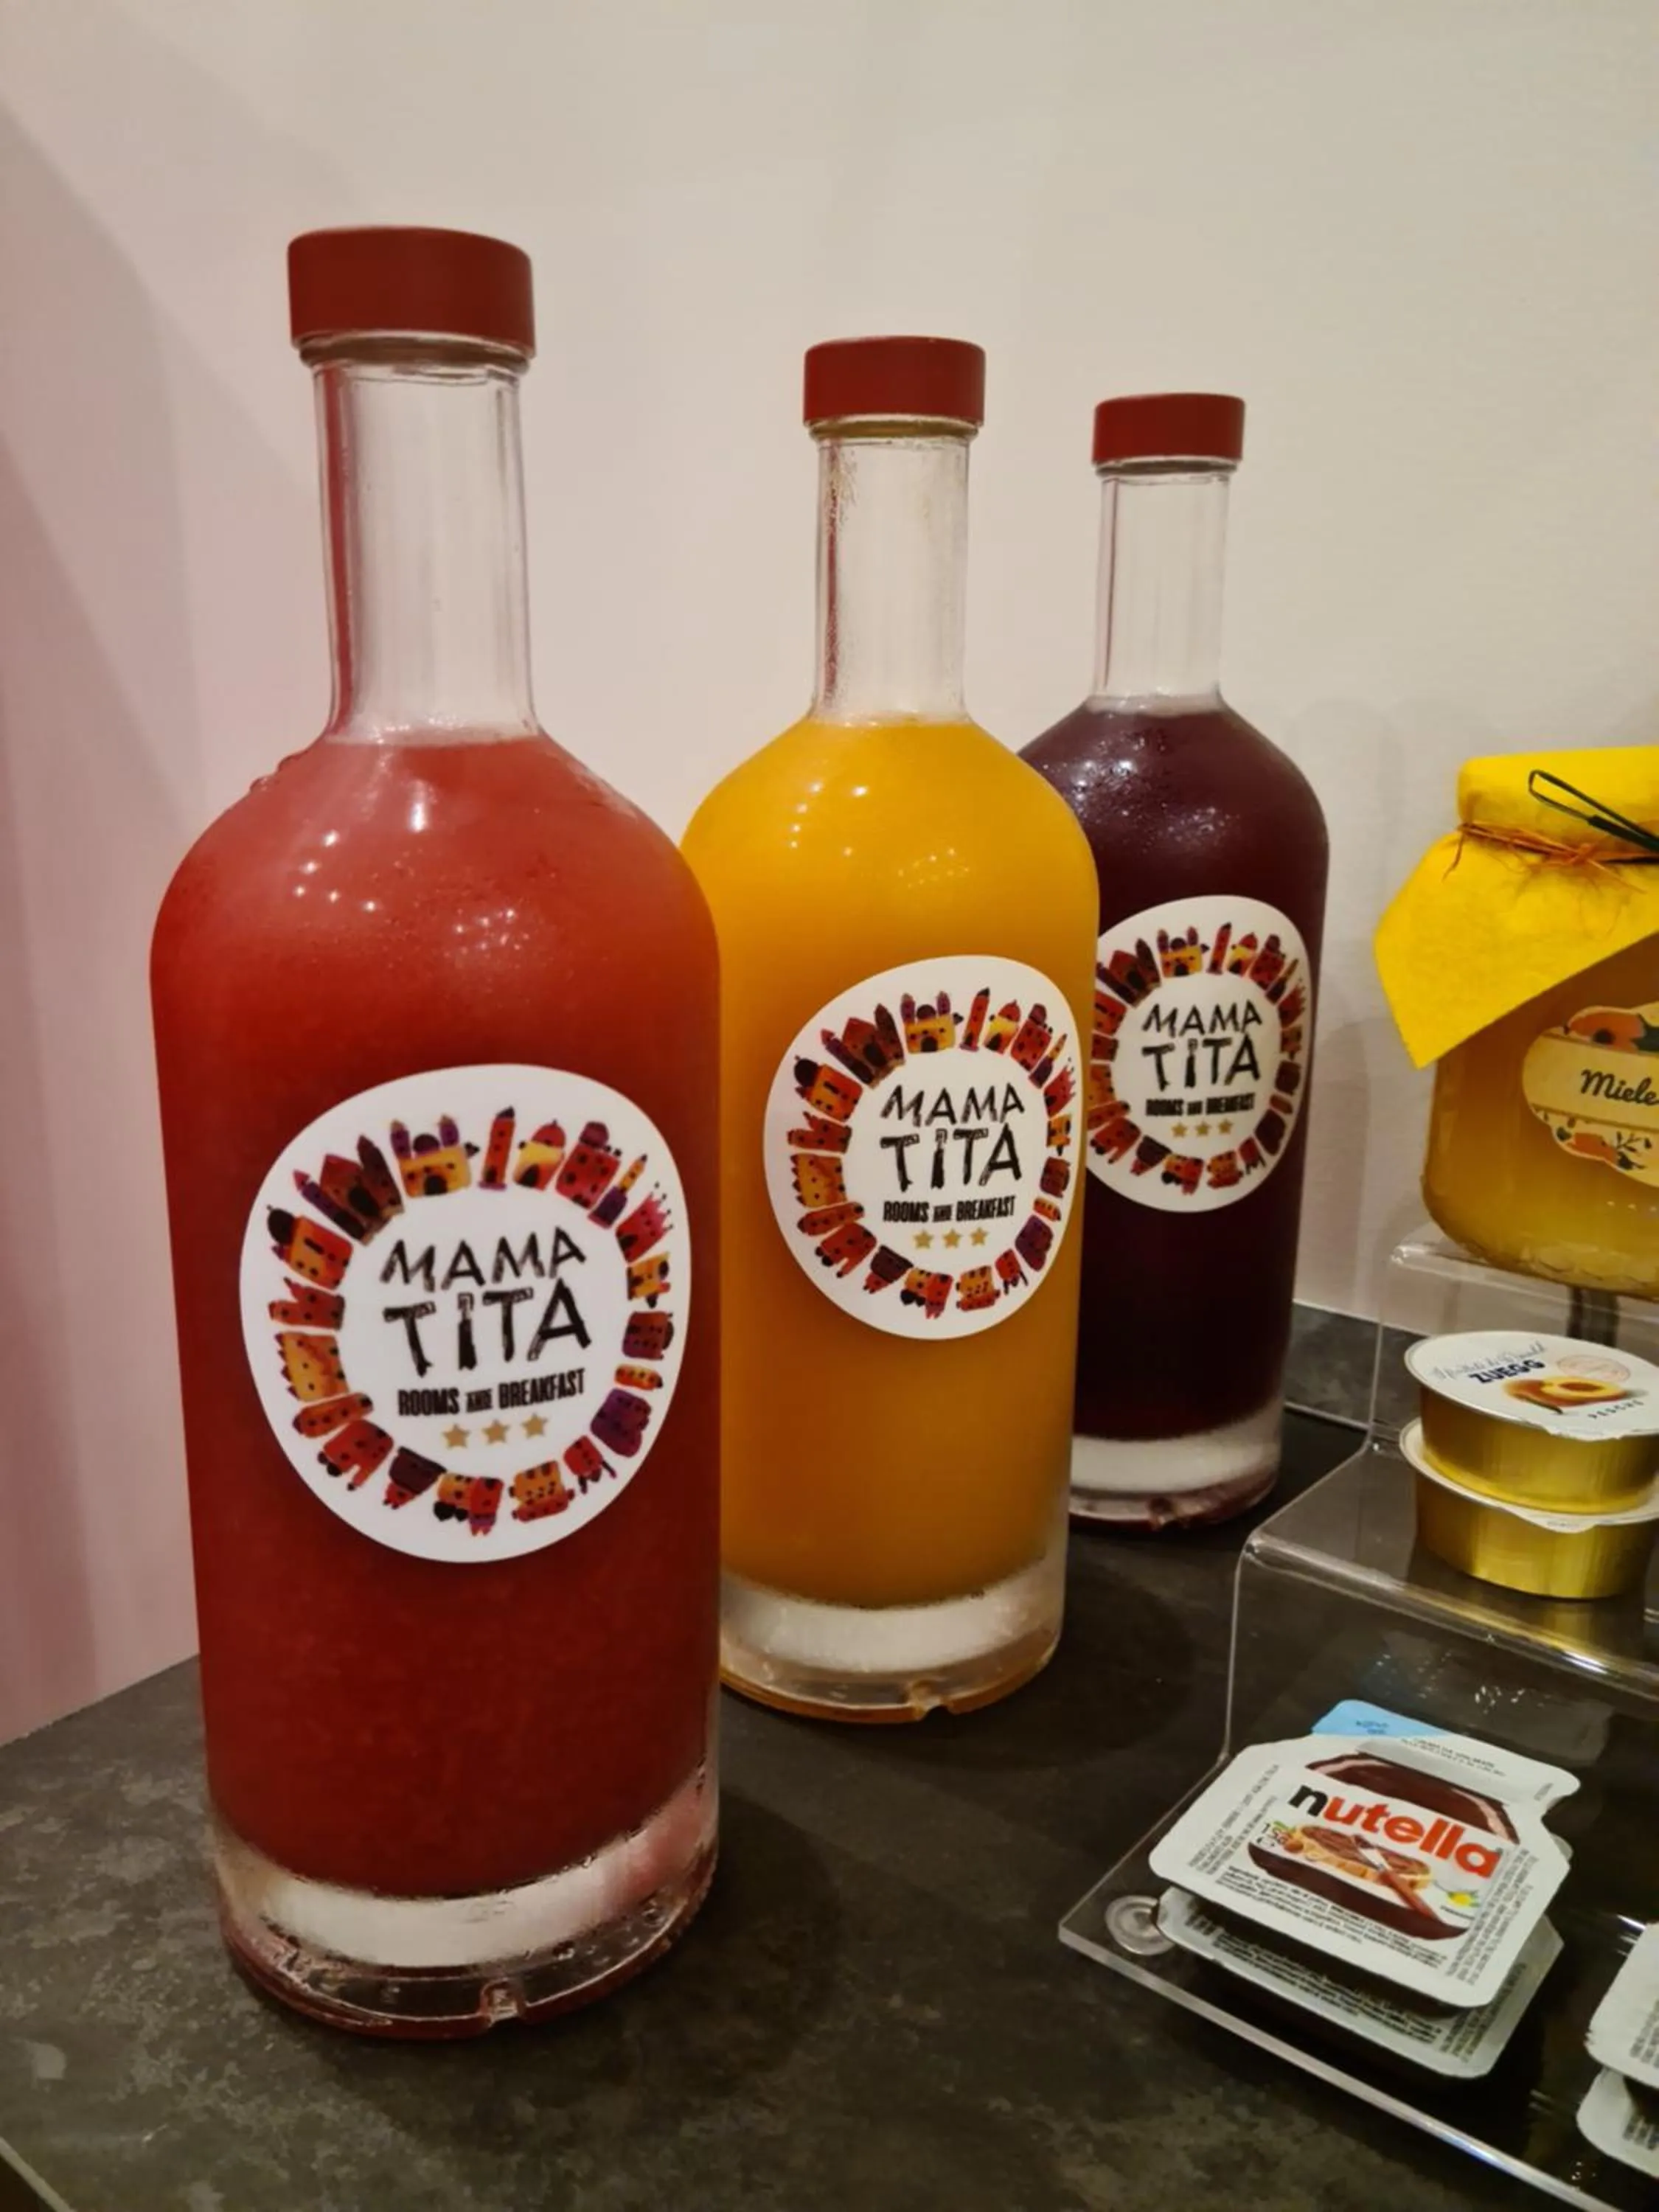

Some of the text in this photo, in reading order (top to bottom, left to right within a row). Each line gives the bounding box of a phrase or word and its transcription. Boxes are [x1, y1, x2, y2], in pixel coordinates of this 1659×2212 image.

[1141, 999, 1262, 1038] MAMA
[1141, 1033, 1260, 1091] TITA
[1581, 1069, 1659, 1106] Miele
[880, 1082, 1025, 1127] MAMA
[880, 1122, 1022, 1192] TITA
[883, 1200, 930, 1222] ROOMS
[956, 1195, 1015, 1222] BREAKFAST
[379, 1225, 586, 1291] MAMA
[382, 1278, 591, 1377] TITA
[398, 1388, 459, 1416] ROOMS
[498, 1368, 585, 1409] BREAKFAST
[1288, 1784, 1503, 1879] nutella
